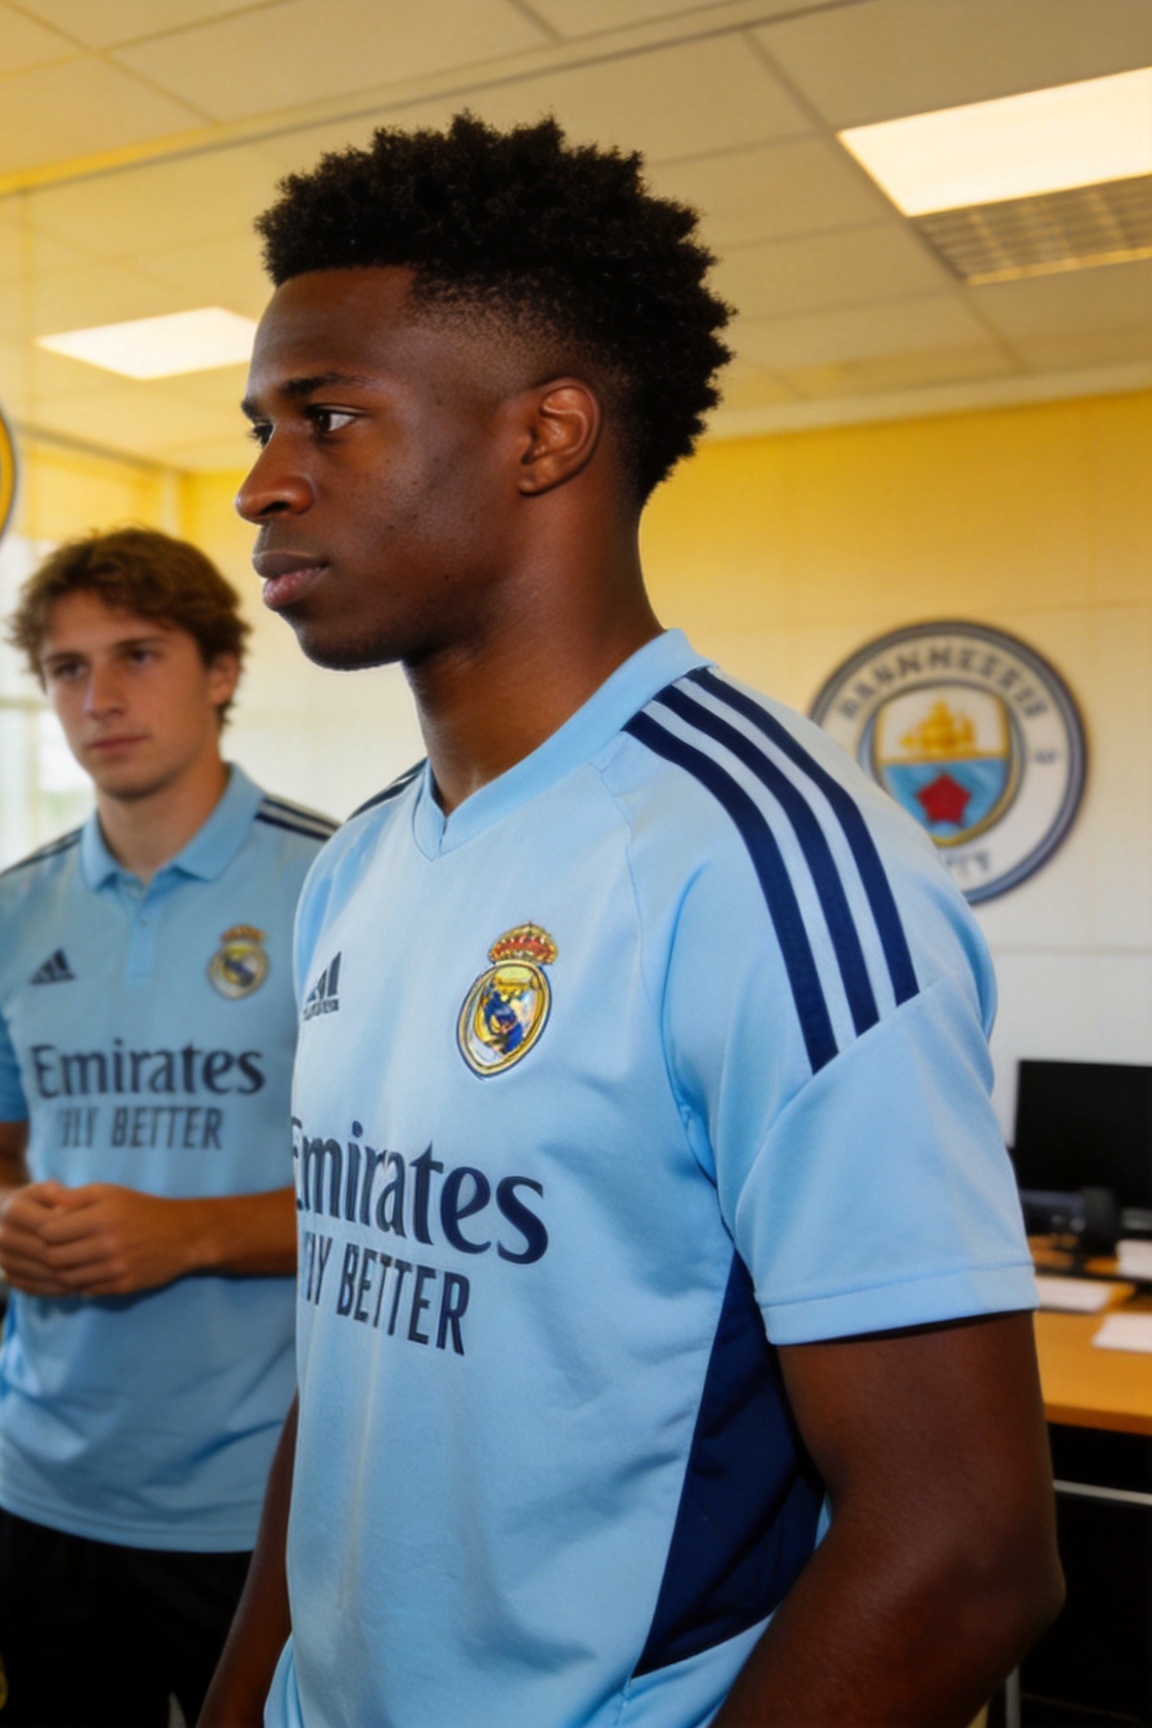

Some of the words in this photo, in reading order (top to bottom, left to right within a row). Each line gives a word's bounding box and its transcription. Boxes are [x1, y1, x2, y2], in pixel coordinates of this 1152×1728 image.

[30, 1038, 266, 1099] Emirates
[111, 1106, 224, 1150] BETTER
[335, 1242, 470, 1357] BETTER
